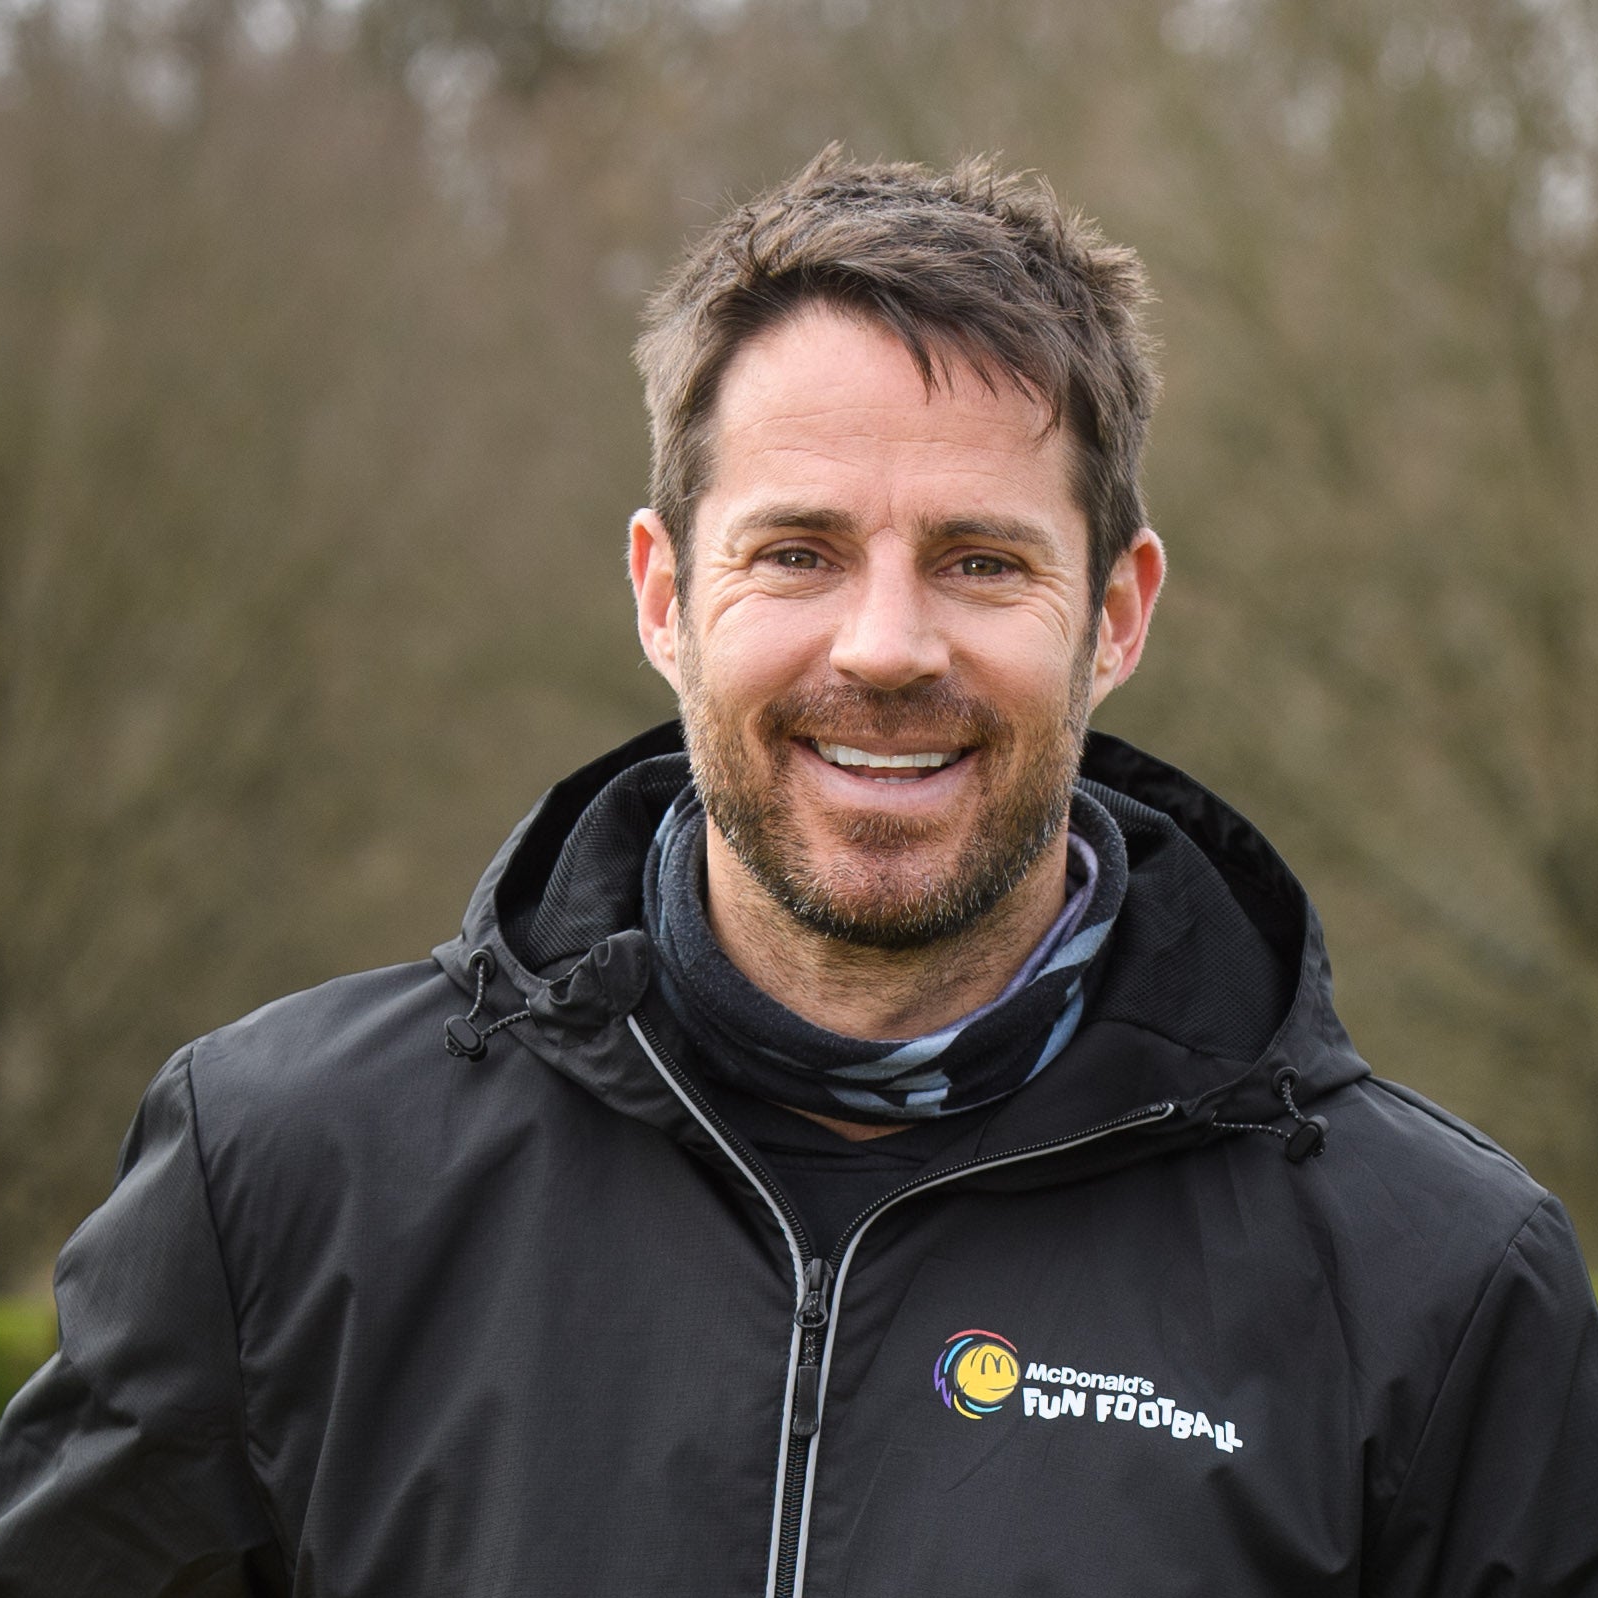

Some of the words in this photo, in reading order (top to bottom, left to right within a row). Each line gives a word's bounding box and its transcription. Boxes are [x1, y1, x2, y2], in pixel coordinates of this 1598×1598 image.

[1025, 1362, 1155, 1395] McDonald's
[1022, 1387, 1086, 1419] FUN
[1095, 1393, 1244, 1453] FOOTBALL
